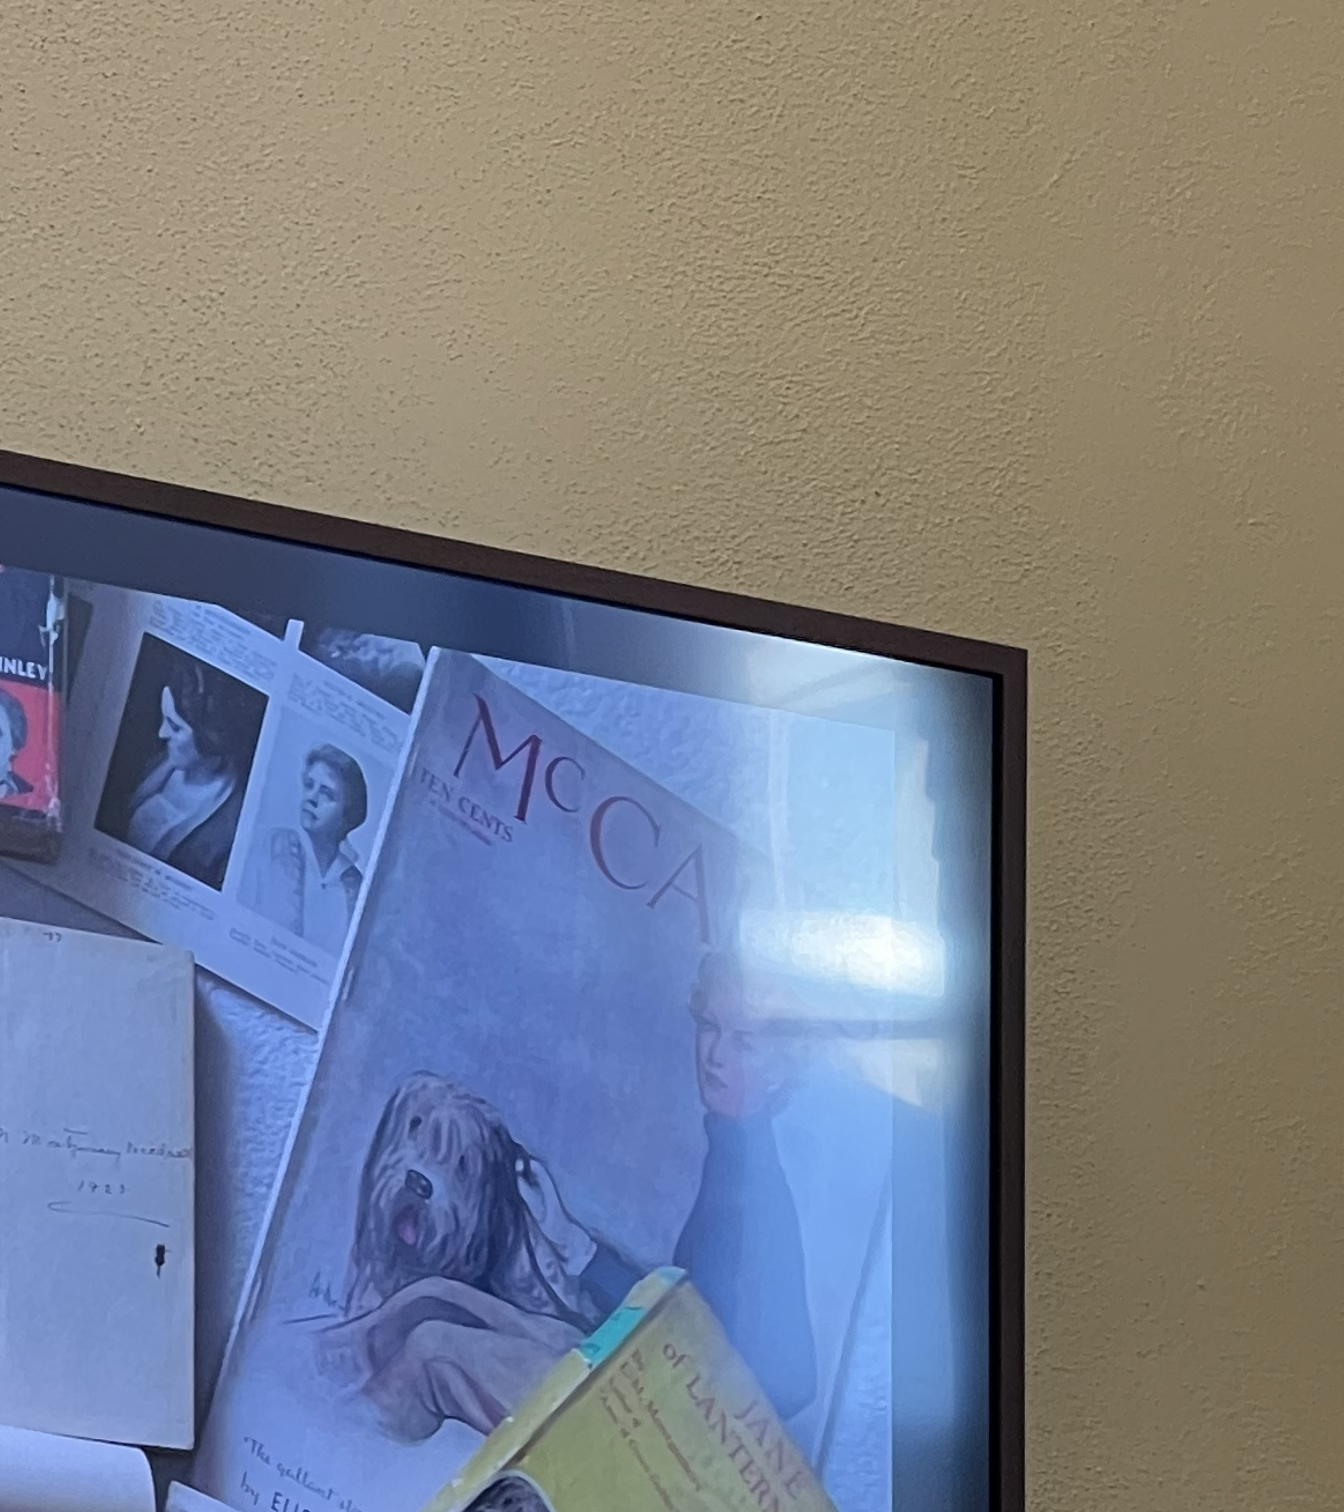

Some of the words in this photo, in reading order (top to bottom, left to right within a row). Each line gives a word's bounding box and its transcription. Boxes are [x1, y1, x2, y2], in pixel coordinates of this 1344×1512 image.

[418, 769, 453, 802] TEN
[458, 796, 512, 842] CENTS
[663, 1343, 686, 1368] of
[734, 1400, 803, 1500] JANE
[241, 1471, 260, 1506] by
